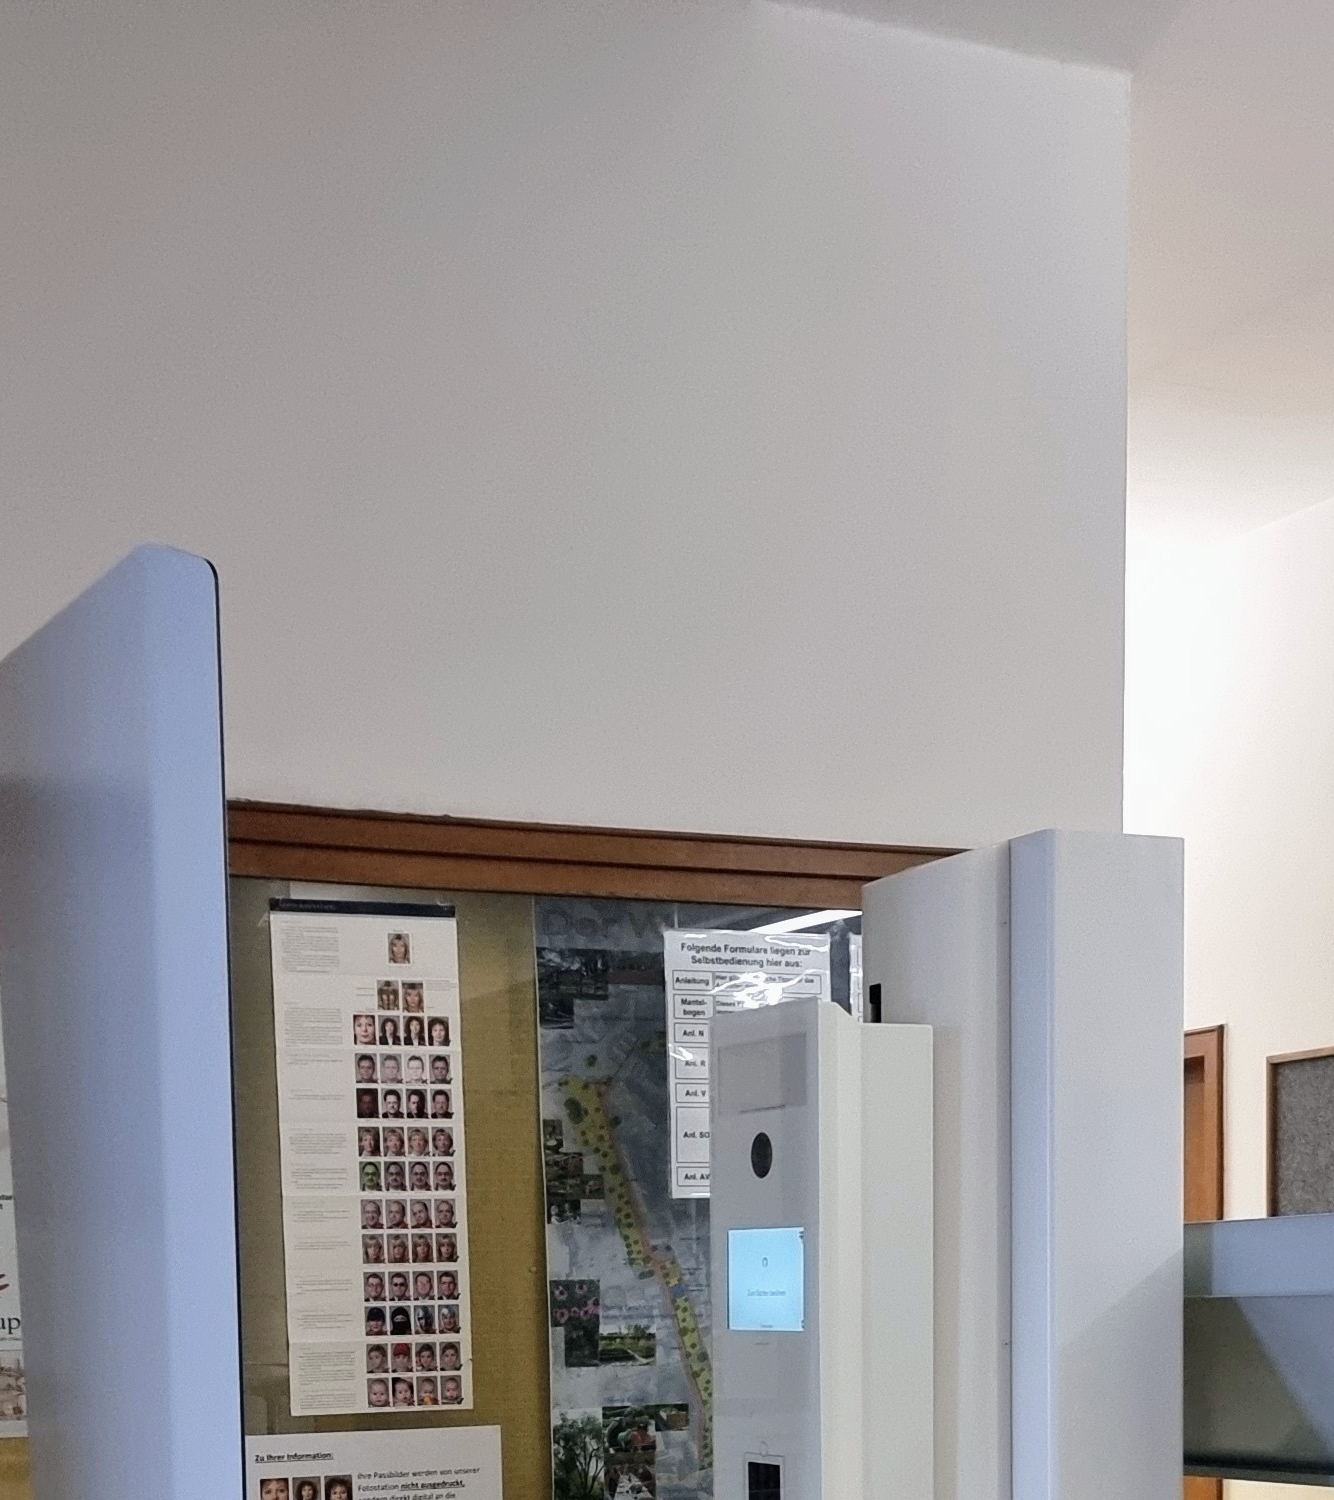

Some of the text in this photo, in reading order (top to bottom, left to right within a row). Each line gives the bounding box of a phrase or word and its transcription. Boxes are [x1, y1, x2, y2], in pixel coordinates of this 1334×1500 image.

[680, 942, 722, 954] Folgende
[723, 944, 767, 955] Formulare
[690, 956, 765, 969] Selbstbedienung
[766, 957, 783, 968] hier
[675, 976, 710, 987] Anleitung
[682, 1008, 706, 1018] bogen
